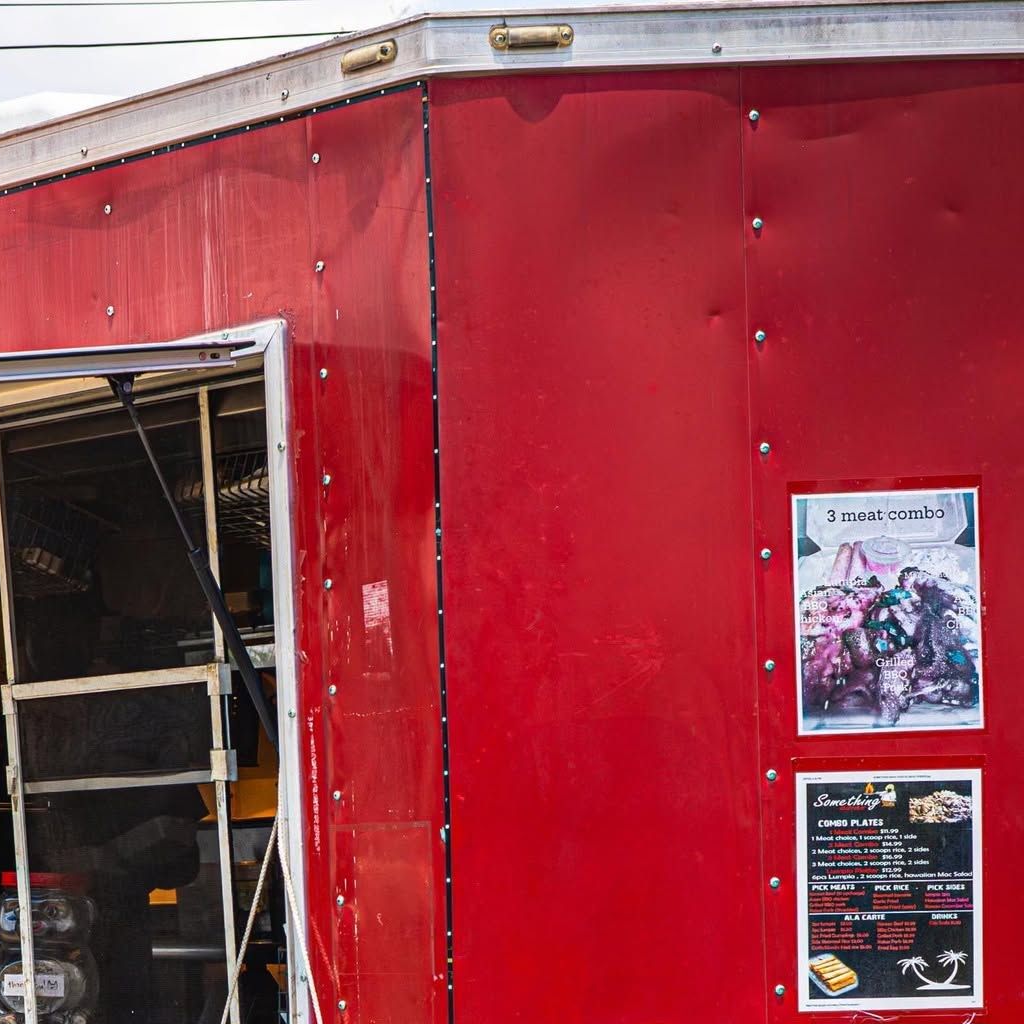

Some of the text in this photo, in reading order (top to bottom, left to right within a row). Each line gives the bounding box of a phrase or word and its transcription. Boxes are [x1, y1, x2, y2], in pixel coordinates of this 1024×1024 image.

[827, 505, 945, 523] 3 meat combo
[803, 601, 828, 612] BBQ
[875, 657, 914, 667] Grilled
[883, 670, 908, 680] BBQ
[813, 793, 881, 811] Something
[818, 818, 884, 828] COMBO PLATES
[828, 873, 855, 881] Lumpia
[865, 873, 888, 881] scoops
[953, 870, 973, 878] Salad
[812, 883, 856, 892] PICK MEATS
[861, 913, 886, 921] CARTE
